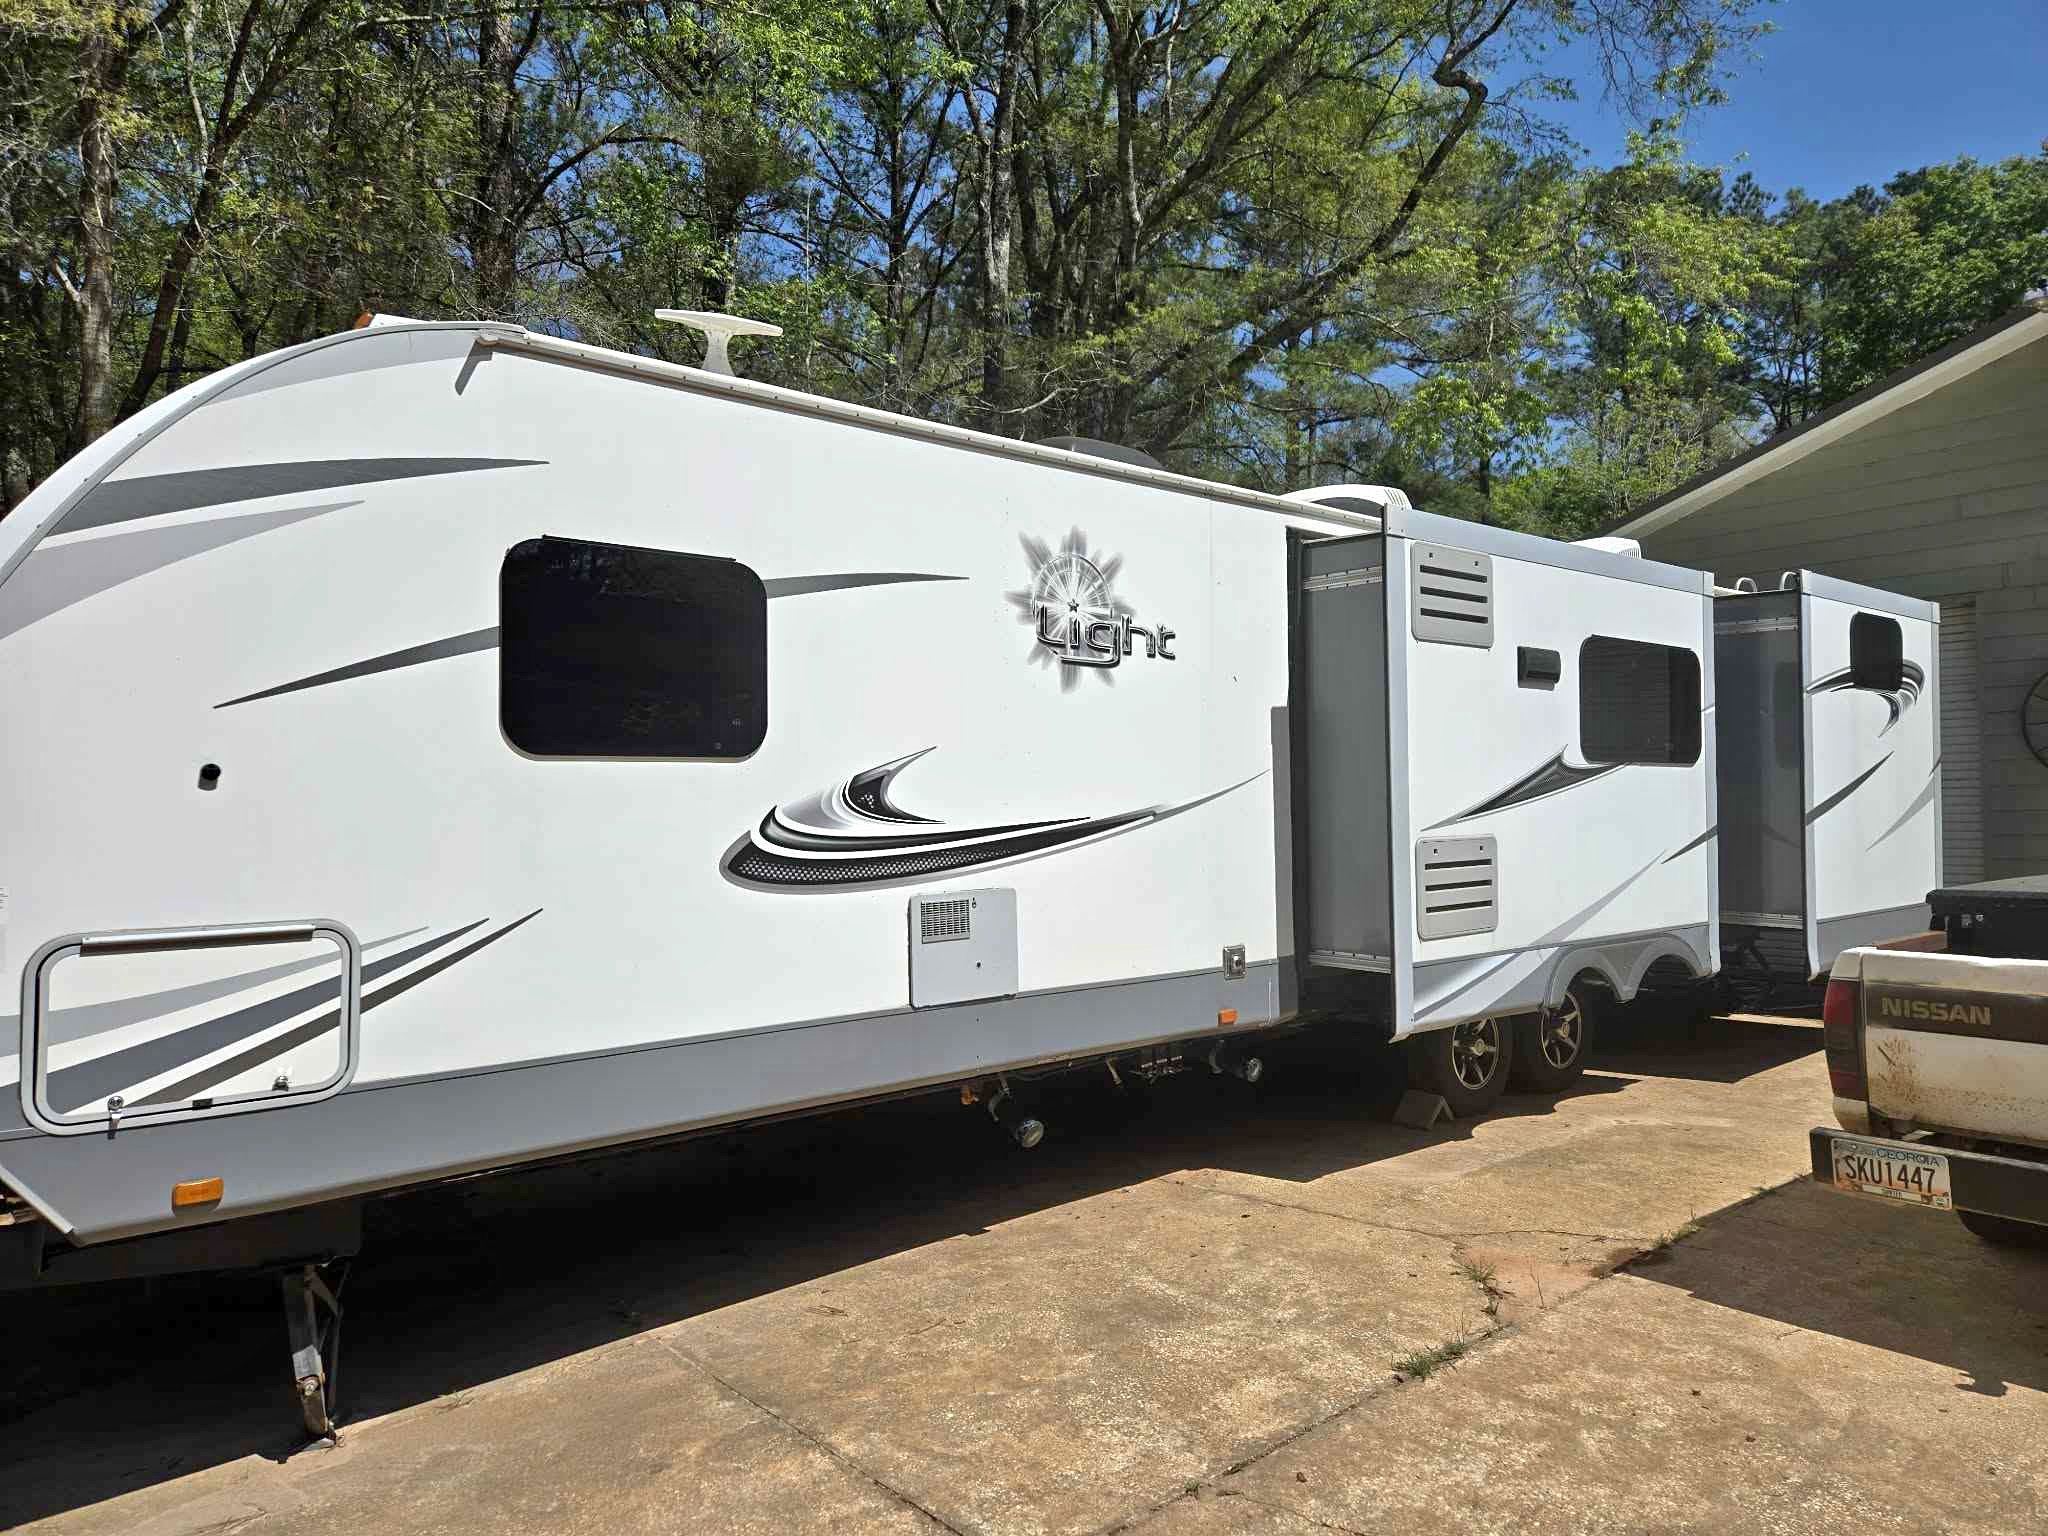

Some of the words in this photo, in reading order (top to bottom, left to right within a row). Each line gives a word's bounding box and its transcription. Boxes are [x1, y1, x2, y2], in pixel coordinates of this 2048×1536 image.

[1035, 601, 1177, 669] Light
[1881, 997, 1992, 1026] NISSAN
[1844, 1155, 1936, 1194] SKU1447
